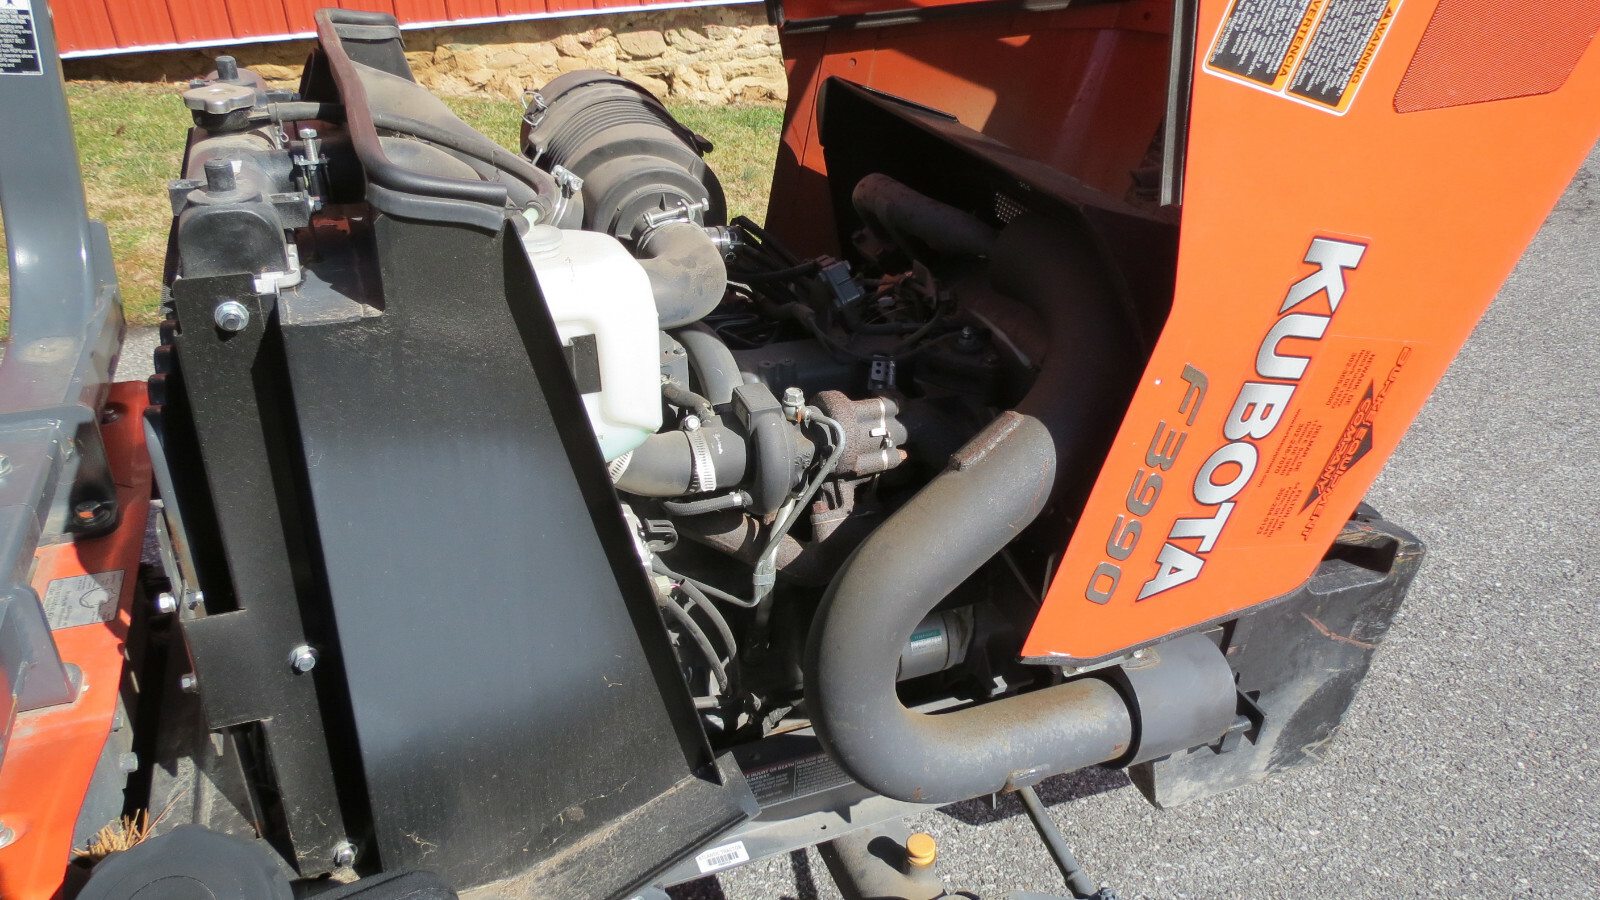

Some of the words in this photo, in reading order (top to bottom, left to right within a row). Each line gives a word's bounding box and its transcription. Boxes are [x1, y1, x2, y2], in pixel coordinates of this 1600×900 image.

[1352, 21, 1377, 64] PERSONAL
[1361, 12, 1376, 33] Diesel
[1265, 36, 1287, 73] Particulate
[1343, 35, 1364, 69] Particulate
[1351, 20, 1389, 84] WARNING
[1335, 66, 1355, 96] INJURY:
[1360, 347, 1412, 424] BURKE
[1136, 235, 1368, 602] KUBOTA
[1299, 425, 1322, 459] DELMAR,
[1313, 396, 1373, 493] COMPANY
[1085, 363, 1209, 605] F3990
[1297, 423, 1369, 539] EQUIPMENT
[720, 844, 741, 853] TRACTOR
